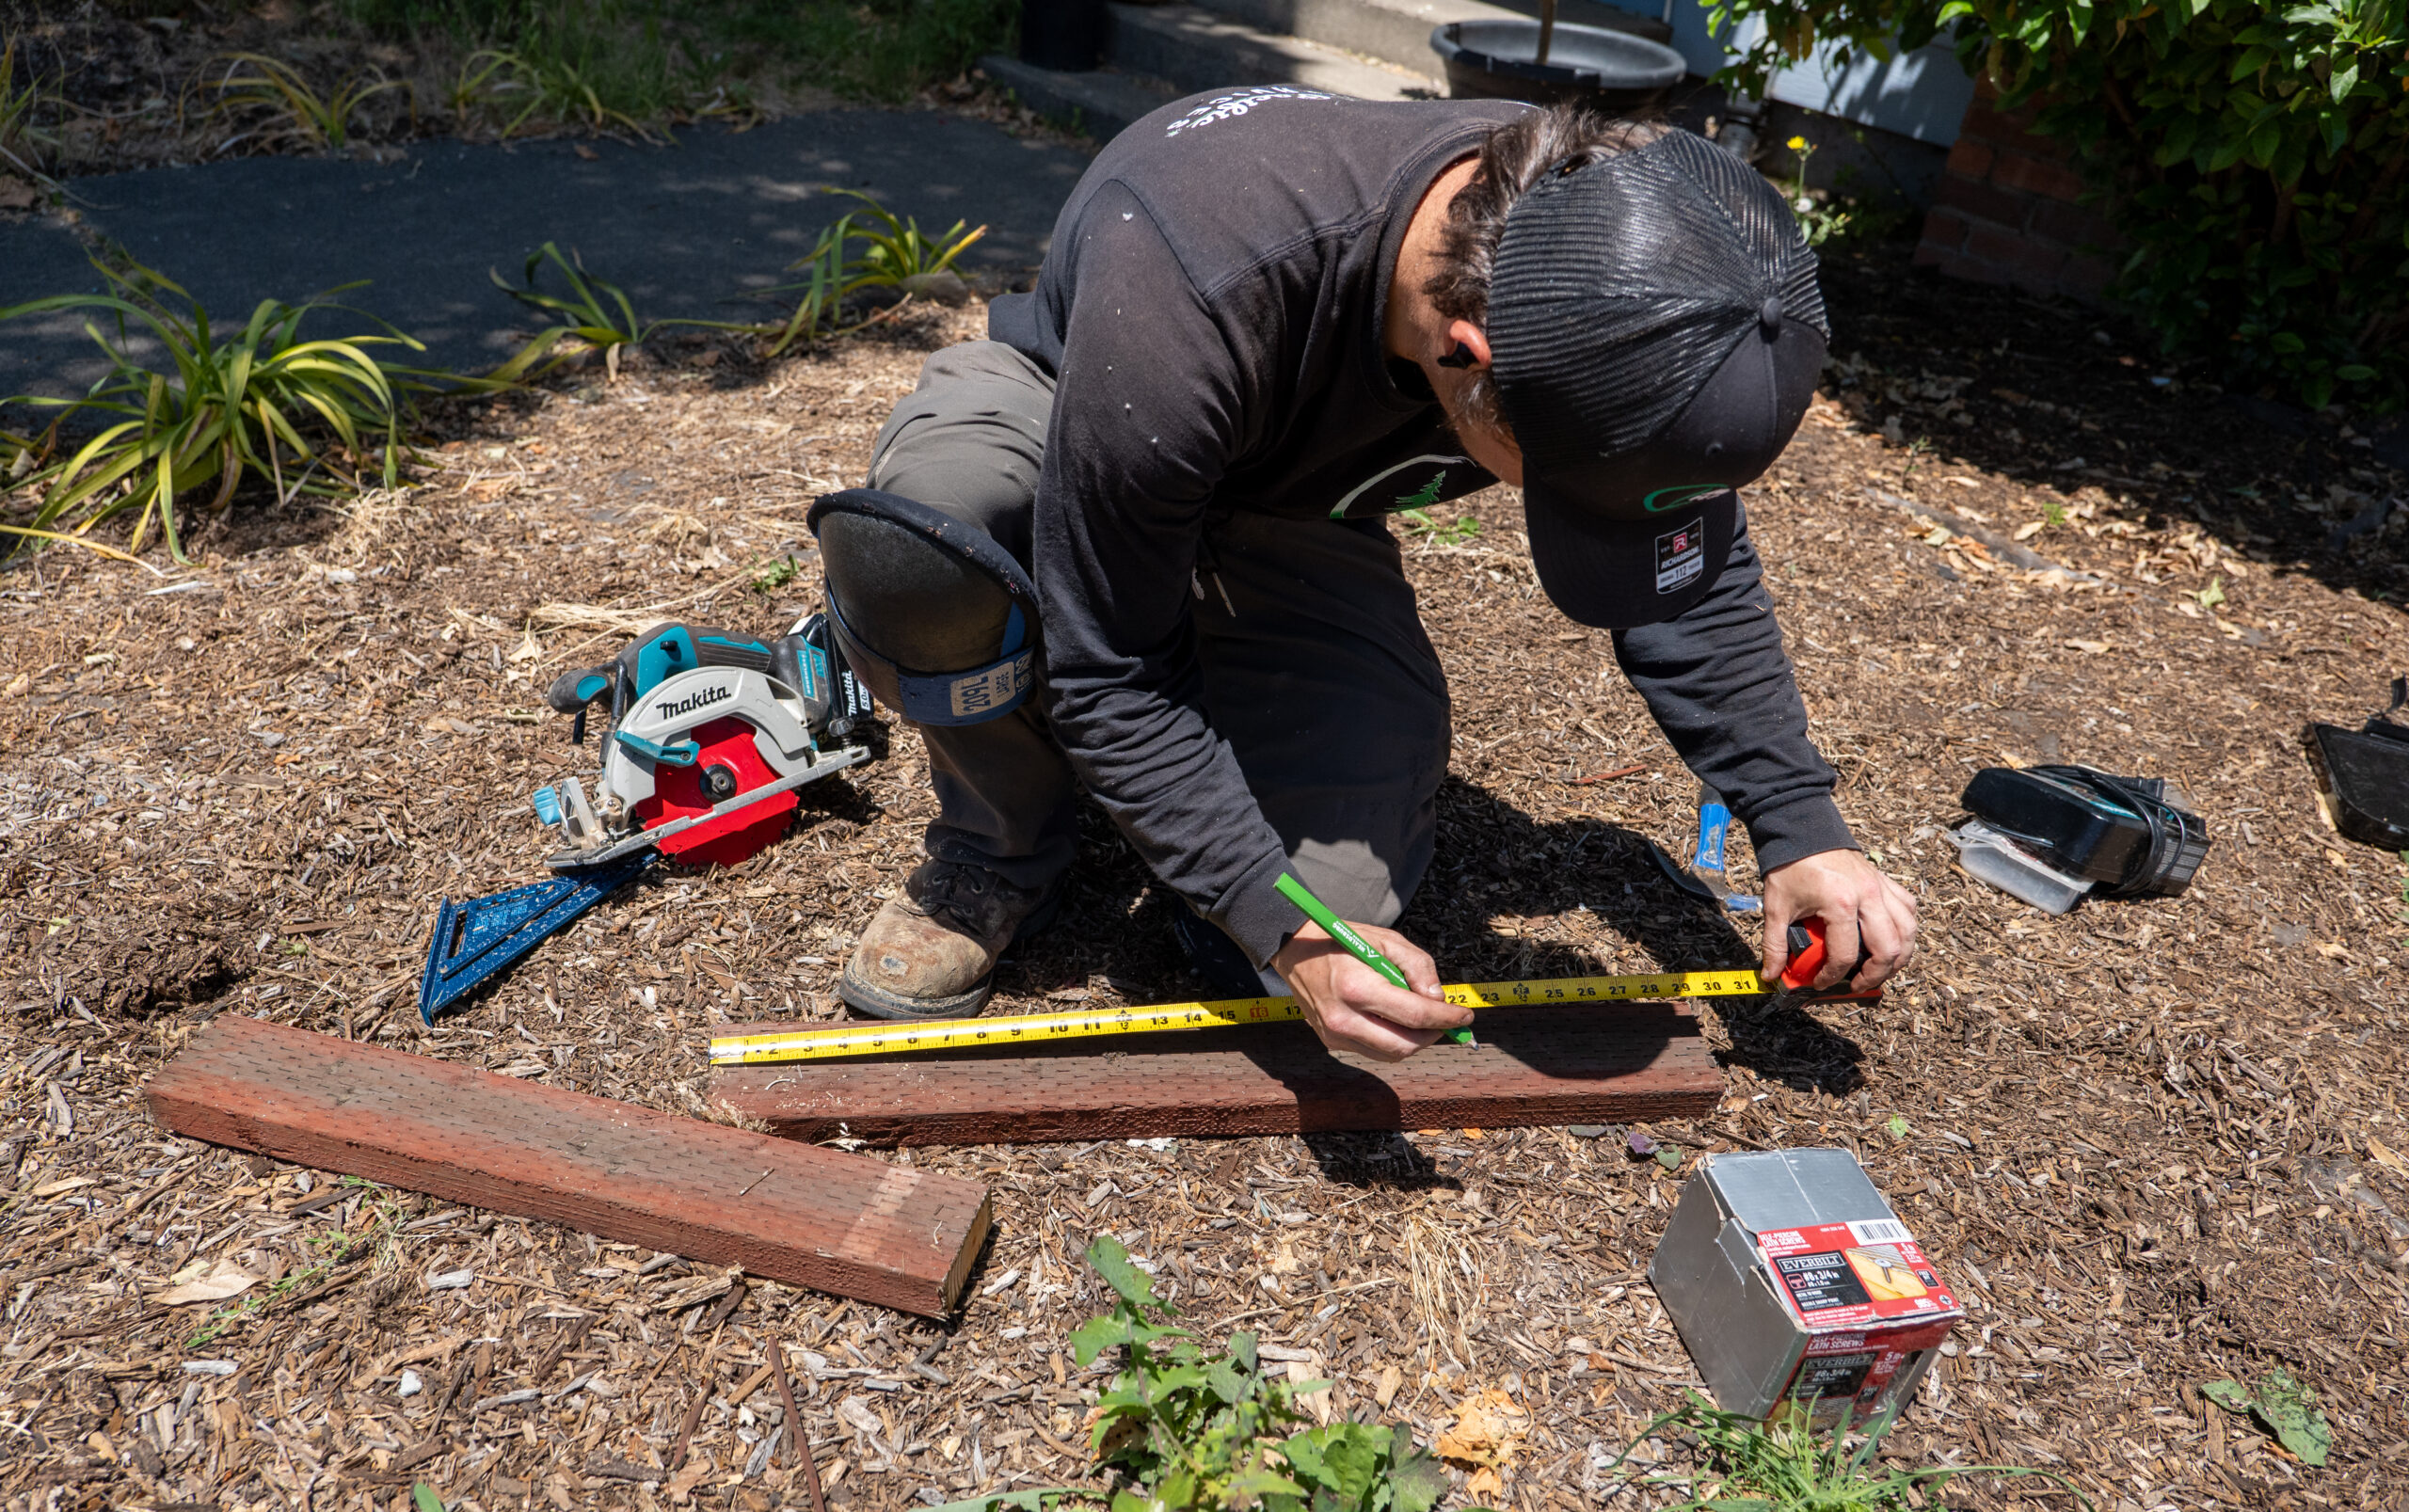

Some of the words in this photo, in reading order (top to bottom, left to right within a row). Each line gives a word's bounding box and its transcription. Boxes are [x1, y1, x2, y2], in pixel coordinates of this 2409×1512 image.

[1168, 86, 1323, 131] RVICES
[1675, 565, 1687, 579] 112
[656, 686, 732, 720] makita
[960, 676, 991, 711] 209L
[1150, 1015, 1169, 1026] 13
[1184, 1012, 1203, 1023] 14
[1218, 1010, 1236, 1020] 15
[1252, 1008, 1267, 1018] 16
[1284, 1005, 1301, 1016] 17
[1447, 995, 1468, 1004] 22
[1480, 992, 1500, 1002] 23
[1544, 989, 1564, 998] 25
[1576, 987, 1597, 996] 26
[1608, 985, 1627, 995] 27
[1640, 984, 1660, 994] 28
[1671, 982, 1691, 993] 29
[1702, 981, 1722, 991] 30
[1733, 980, 1752, 990] 31
[1781, 1254, 1841, 1270] EVERBILT
[1817, 1270, 1833, 1281] 3/4
[1808, 1341, 1829, 1350] LATH
[1830, 1339, 1864, 1349] SCREWS
